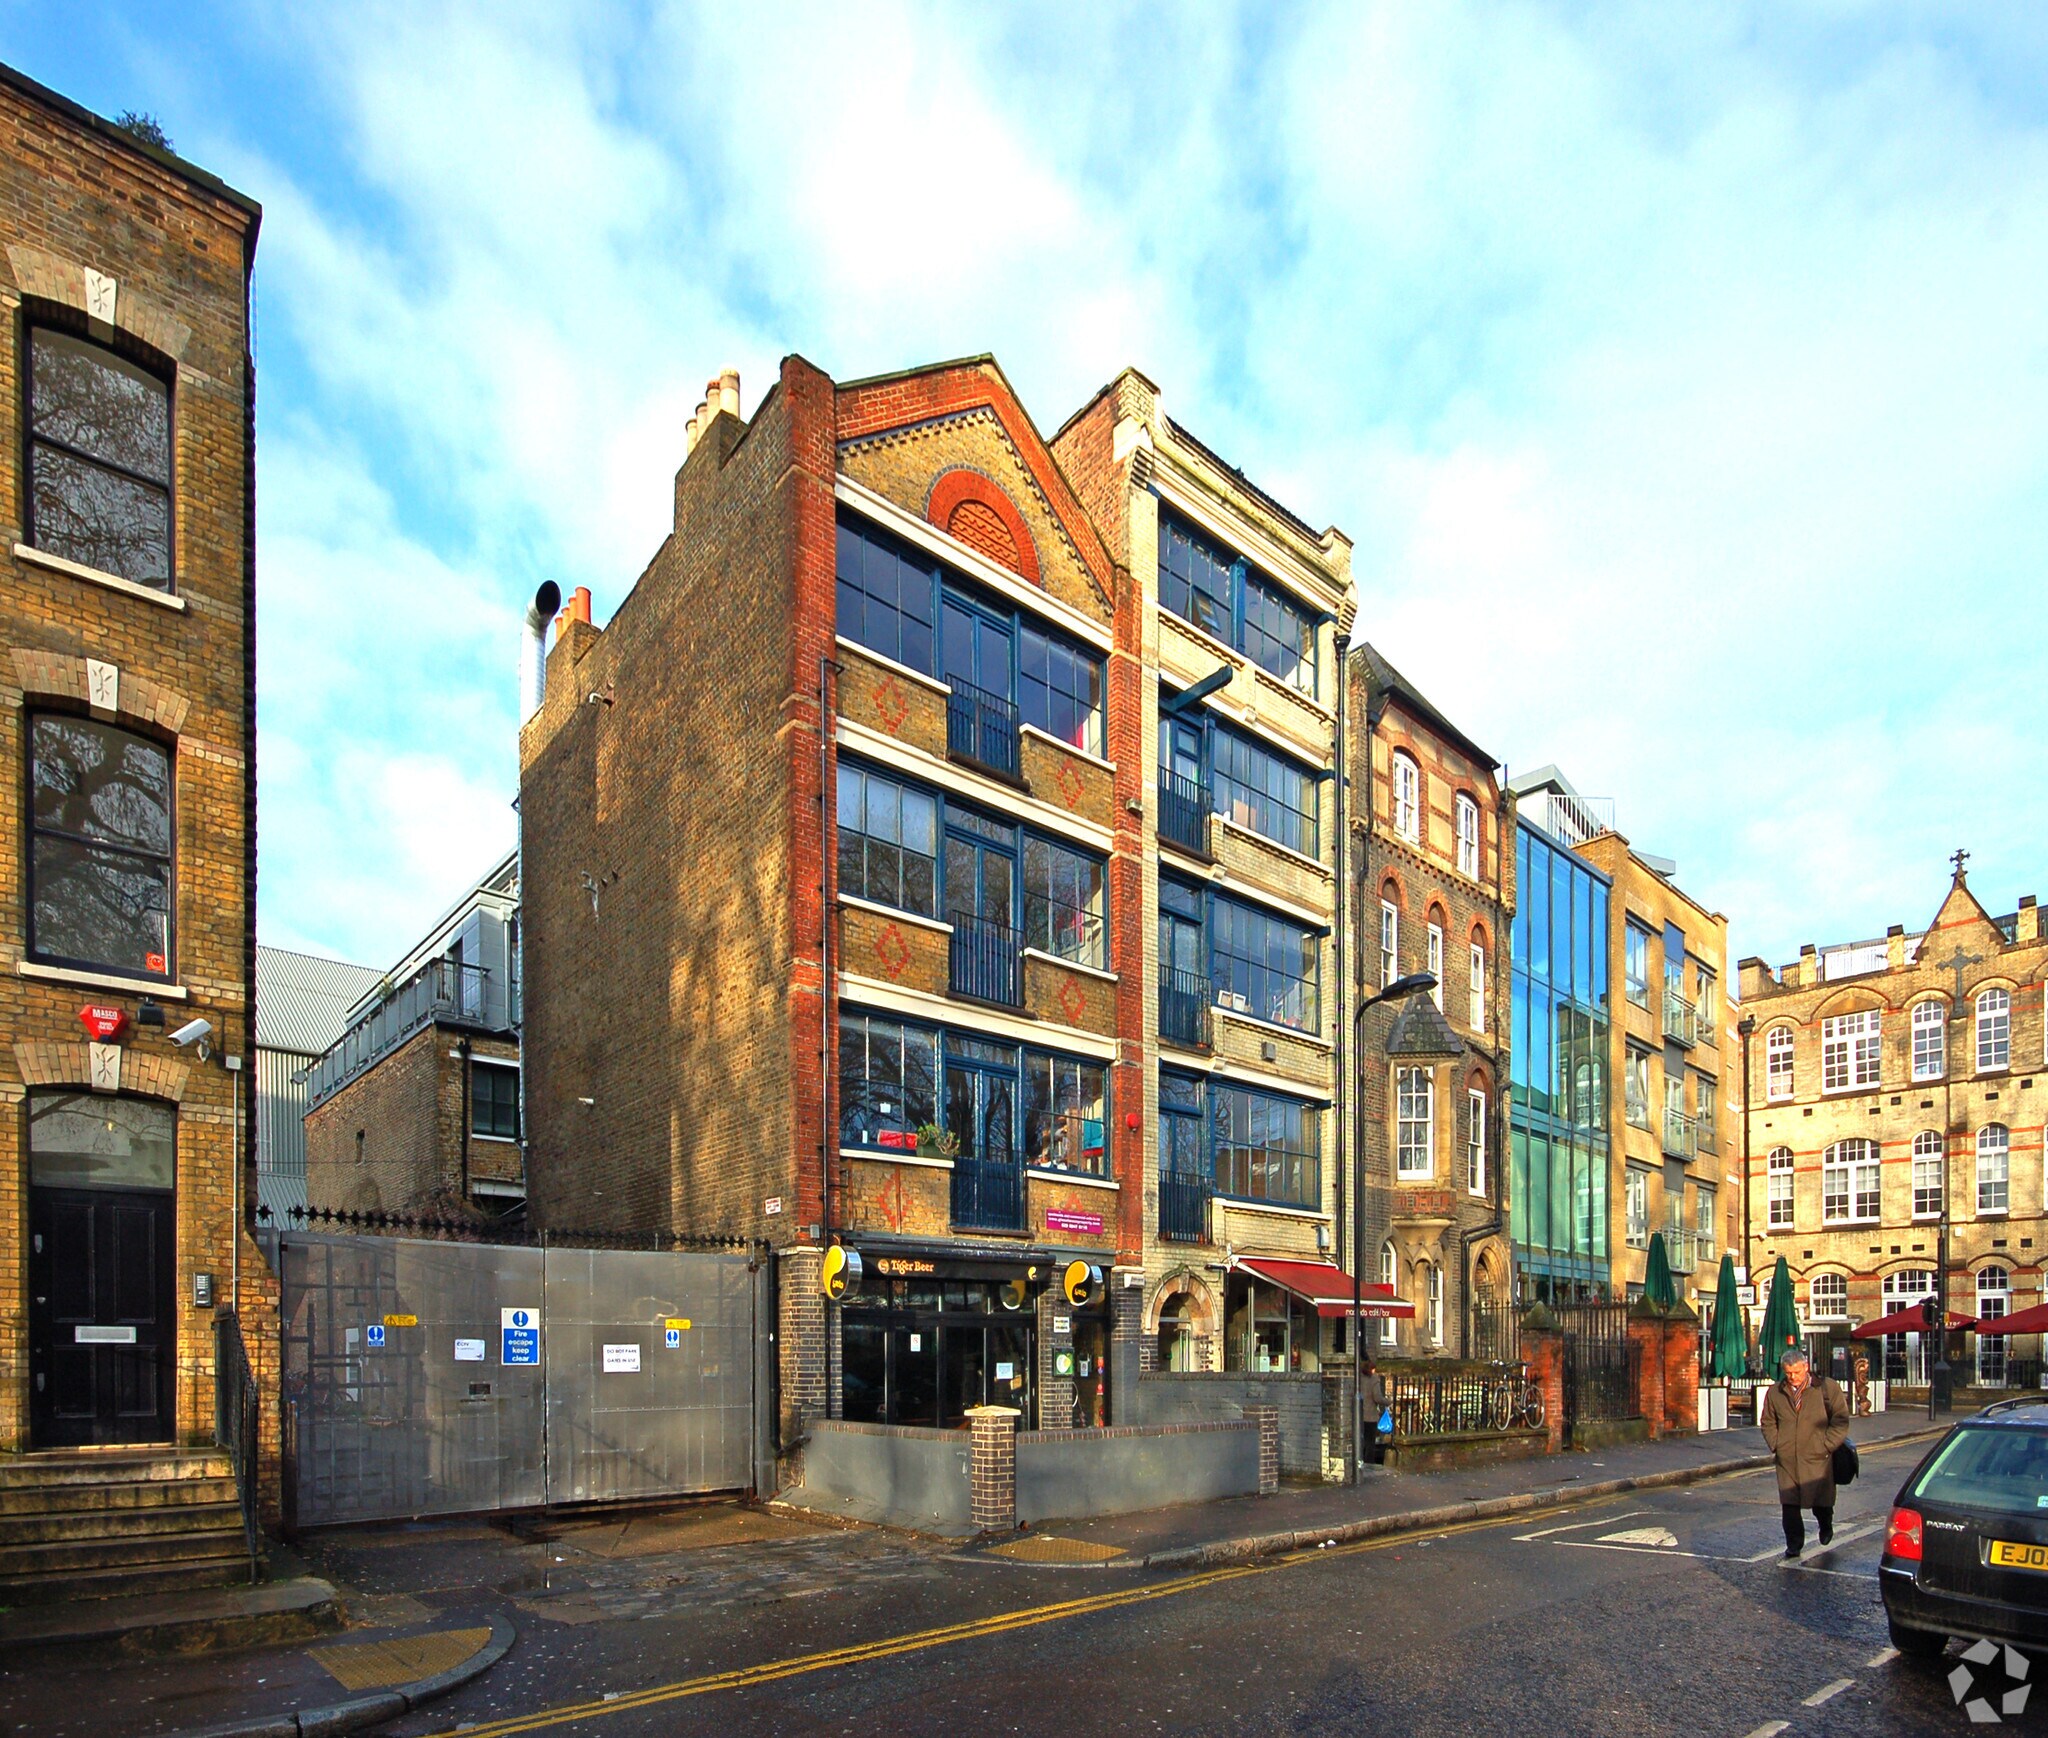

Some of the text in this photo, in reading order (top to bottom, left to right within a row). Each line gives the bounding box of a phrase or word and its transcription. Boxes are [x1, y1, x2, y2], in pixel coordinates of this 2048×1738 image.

[891, 1260, 935, 1275] Tiger Beer
[508, 1339, 534, 1347] escape
[512, 1347, 530, 1355] keep
[1926, 1520, 1965, 1532] PASSAT
[2001, 1545, 2048, 1566] EJ0
